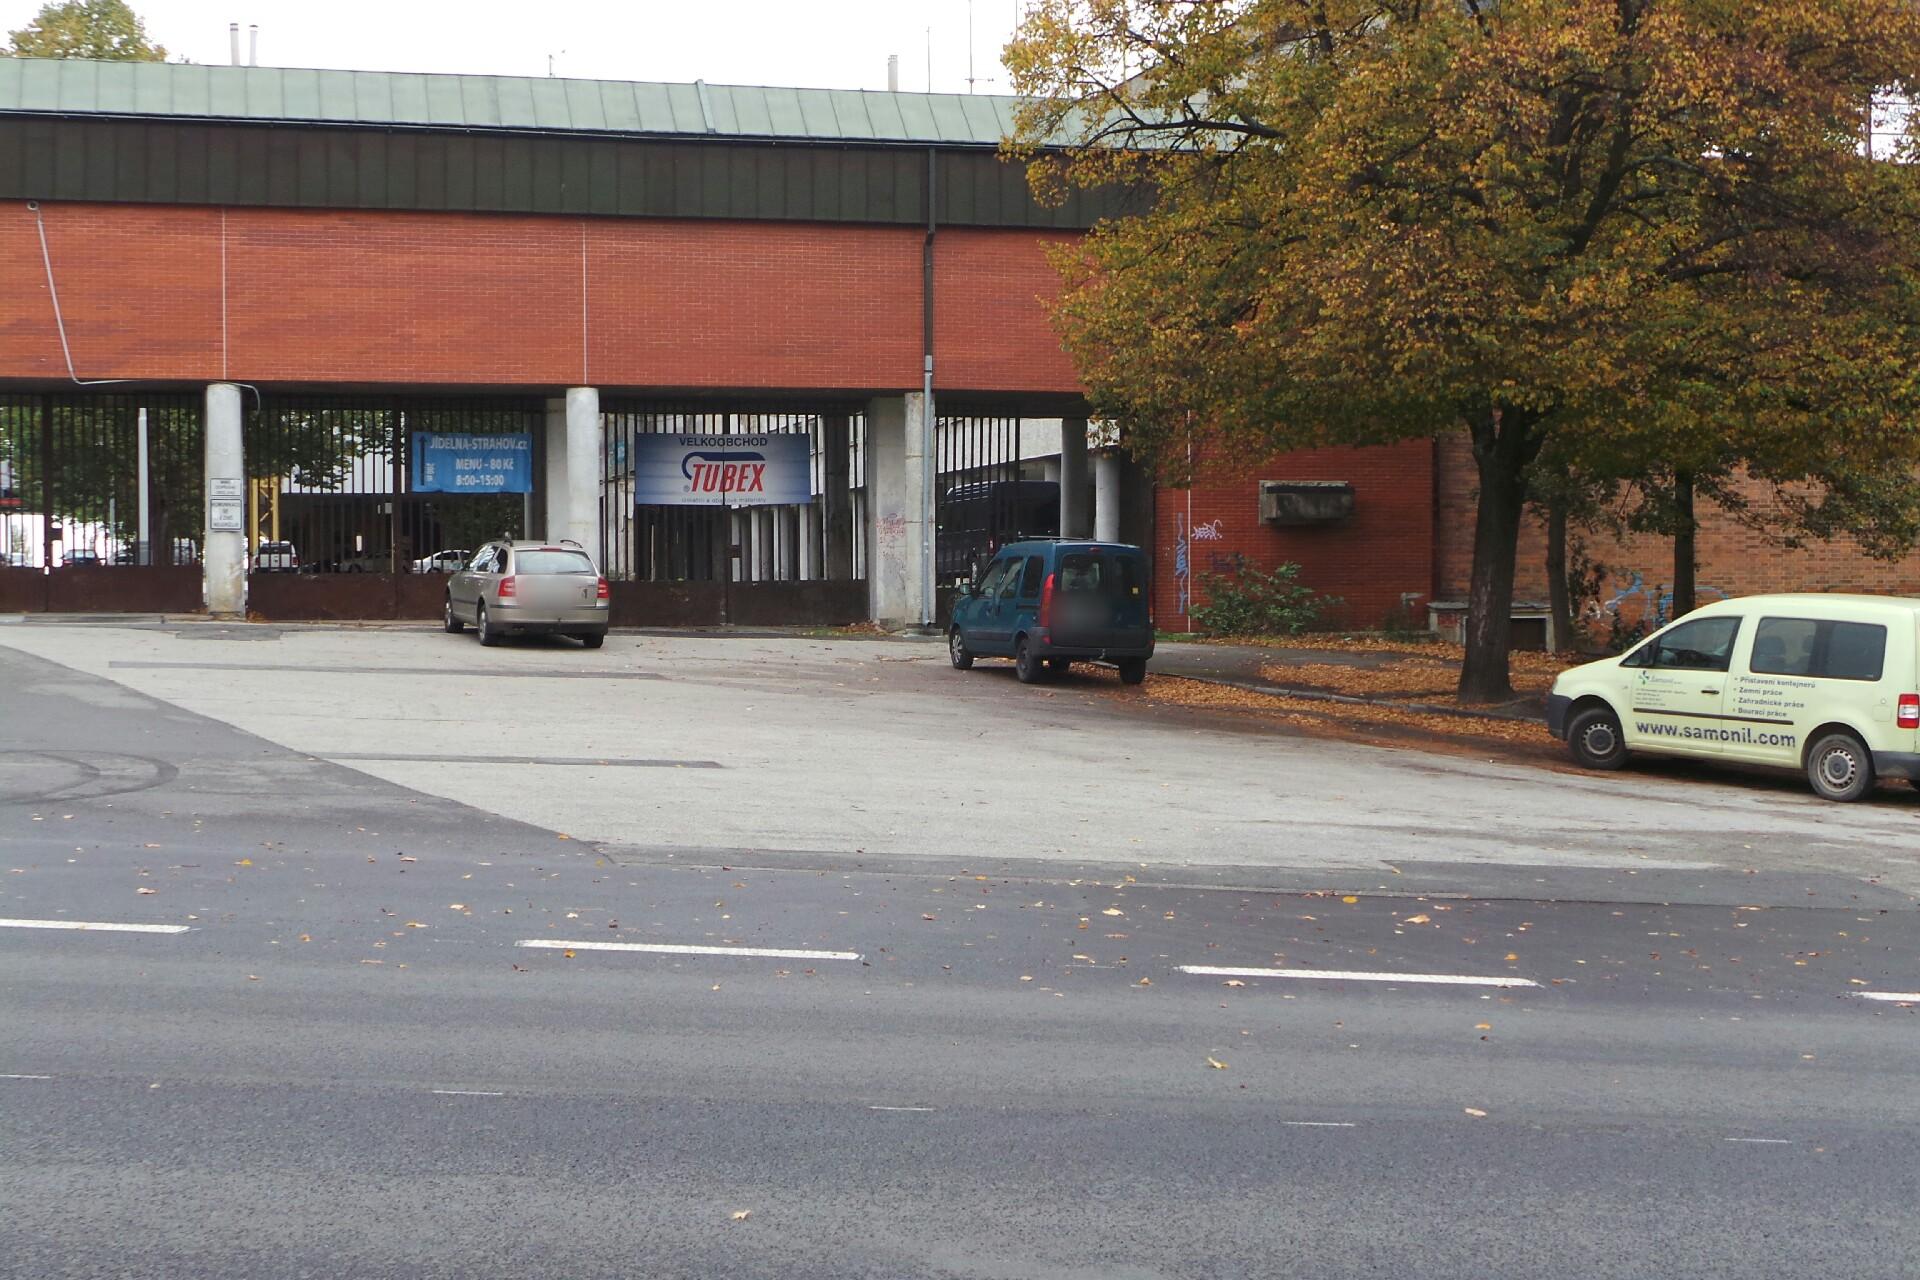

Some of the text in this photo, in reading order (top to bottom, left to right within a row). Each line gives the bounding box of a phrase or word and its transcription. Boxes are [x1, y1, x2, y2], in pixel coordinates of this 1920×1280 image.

[430, 435, 528, 450] JÍDELNA-STRAHOV.cz
[679, 437, 768, 447] VELKOOBCHOD
[455, 458, 482, 470] MENU
[490, 458, 501, 470] 80
[691, 463, 766, 493] TUBEX
[1636, 721, 1796, 748] www.samonil.com
